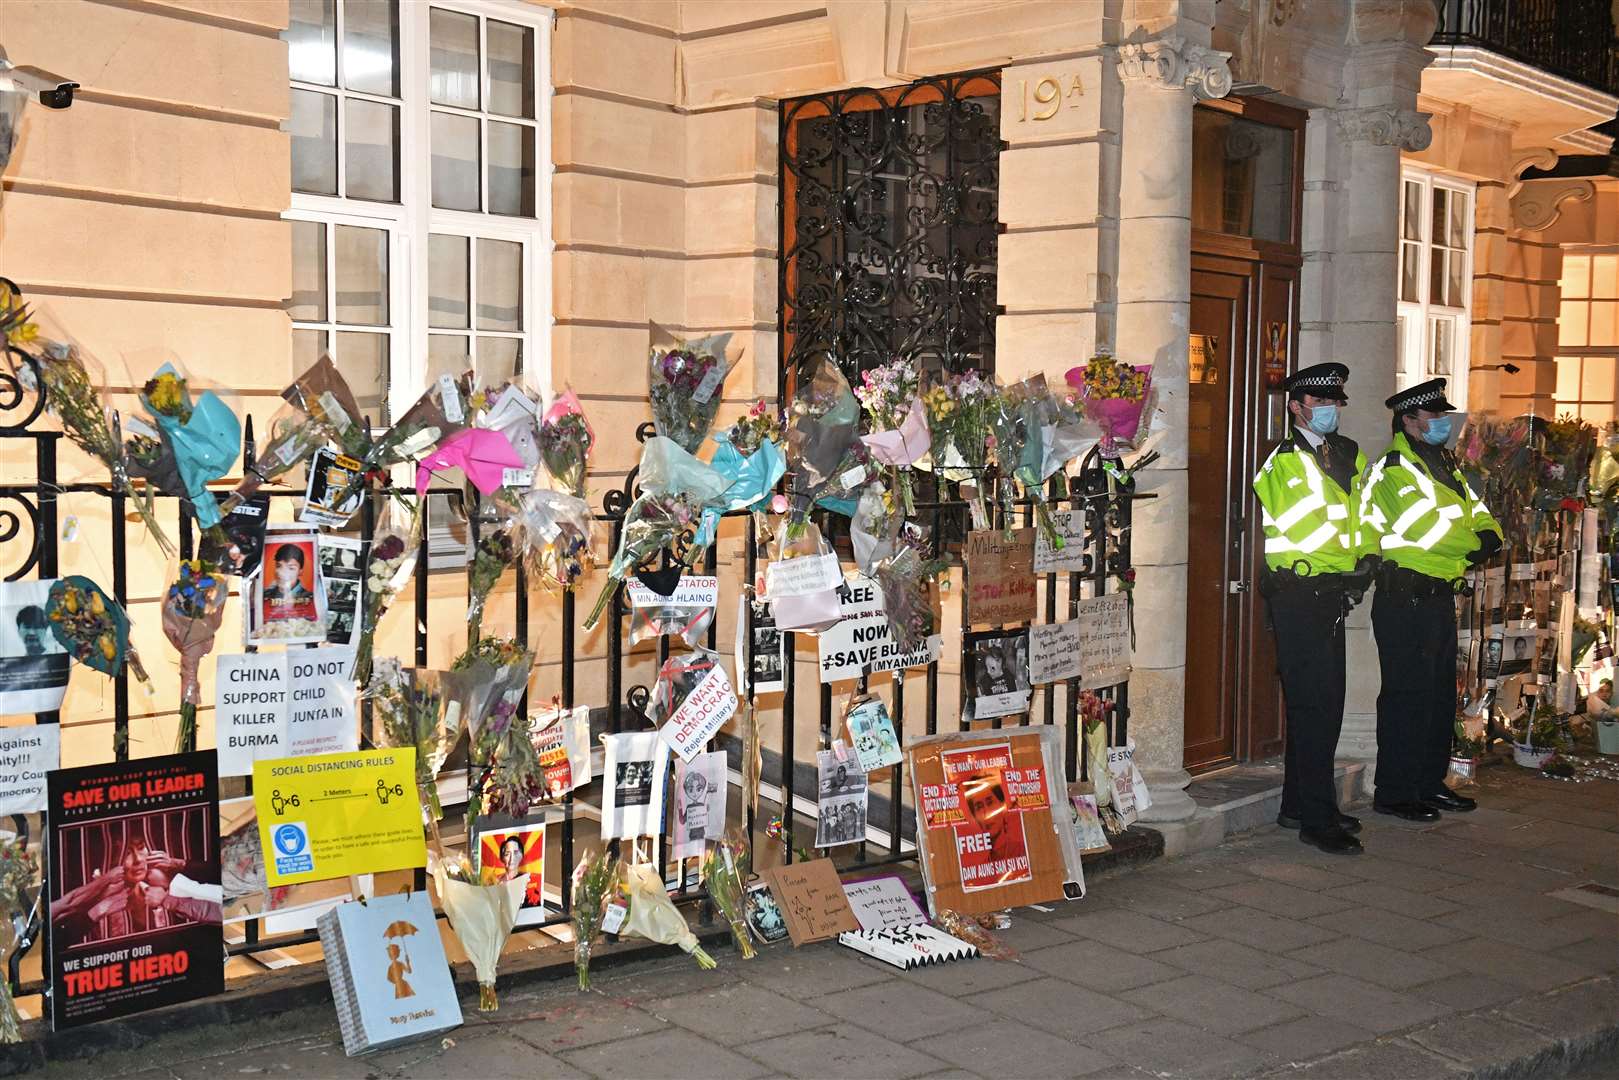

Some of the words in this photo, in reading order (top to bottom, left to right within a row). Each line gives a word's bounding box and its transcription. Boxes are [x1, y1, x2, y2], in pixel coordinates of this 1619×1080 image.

[337, 456, 360, 469] news
[637, 594, 652, 603] MIN
[653, 594, 674, 603] AUNG
[676, 593, 713, 603] HLAING
[853, 624, 889, 643] NOW
[823, 645, 878, 671] #SAVE
[881, 640, 928, 657] BUMA
[229, 667, 281, 682] CHINA
[293, 664, 314, 679] DO
[317, 660, 345, 677] NOT
[223, 691, 286, 705] SUPPORT
[293, 687, 326, 702] CHILD
[672, 705, 690, 726] WE
[689, 673, 721, 708] WANT
[232, 712, 276, 726] KILLER
[292, 708, 329, 723] JUNTA
[331, 707, 343, 719] IN
[675, 682, 732, 744] DEMOCRAC
[683, 730, 708, 756] Reject
[704, 703, 733, 732] Military
[228, 733, 280, 748] BURMA
[0, 754, 31, 767] ity!!!
[271, 766, 305, 777] SOCIAL
[307, 759, 363, 773] DISTANCING
[366, 756, 395, 767] RULES
[1005, 769, 1021, 782] END
[1025, 769, 1040, 780] THE
[63, 787, 105, 809] SAVE
[108, 782, 142, 802] OUR
[146, 772, 205, 796] LEADER
[923, 785, 939, 798] END
[942, 783, 959, 796] THE
[1007, 782, 1041, 795] DICTATORSHIP
[924, 796, 960, 811] DICTATORSHIP
[958, 832, 992, 855] FREE
[963, 866, 977, 880] DAW
[978, 862, 995, 877] AUNG
[995, 859, 1007, 874] SAN
[1007, 858, 1017, 872] SU
[63, 960, 81, 972] WE
[83, 949, 130, 968] SUPPORT
[132, 944, 153, 958] OUR
[63, 962, 124, 997] TRUE
[129, 950, 190, 983] HERO
